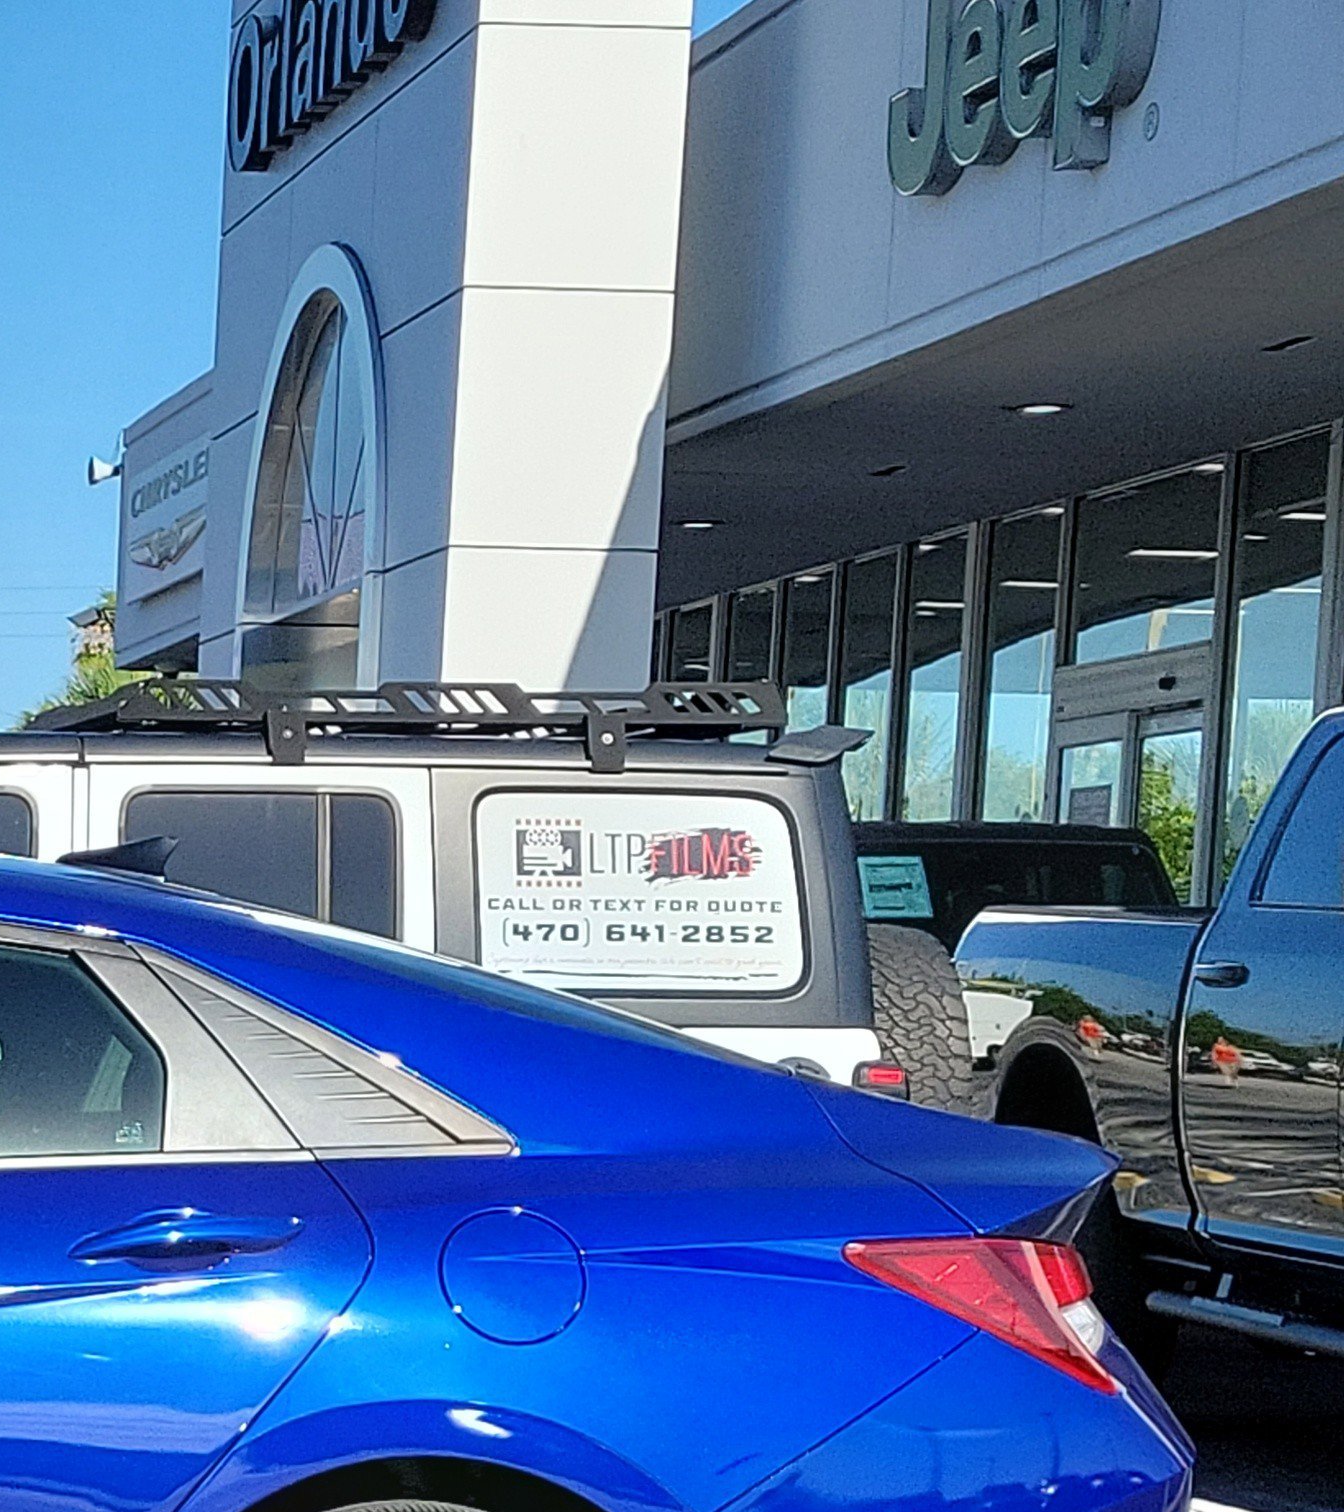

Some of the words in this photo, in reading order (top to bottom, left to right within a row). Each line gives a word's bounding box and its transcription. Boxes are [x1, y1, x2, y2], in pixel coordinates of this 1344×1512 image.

[131, 446, 210, 518] CHRYSLE
[650, 831, 755, 877] FILMS
[487, 897, 545, 912] CALL
[552, 898, 583, 912] OR
[590, 899, 646, 912] TEXT
[655, 900, 699, 913] FOR
[707, 900, 783, 914] QUOTE
[502, 917, 591, 948] (470)
[605, 923, 775, 944] 641-2852
